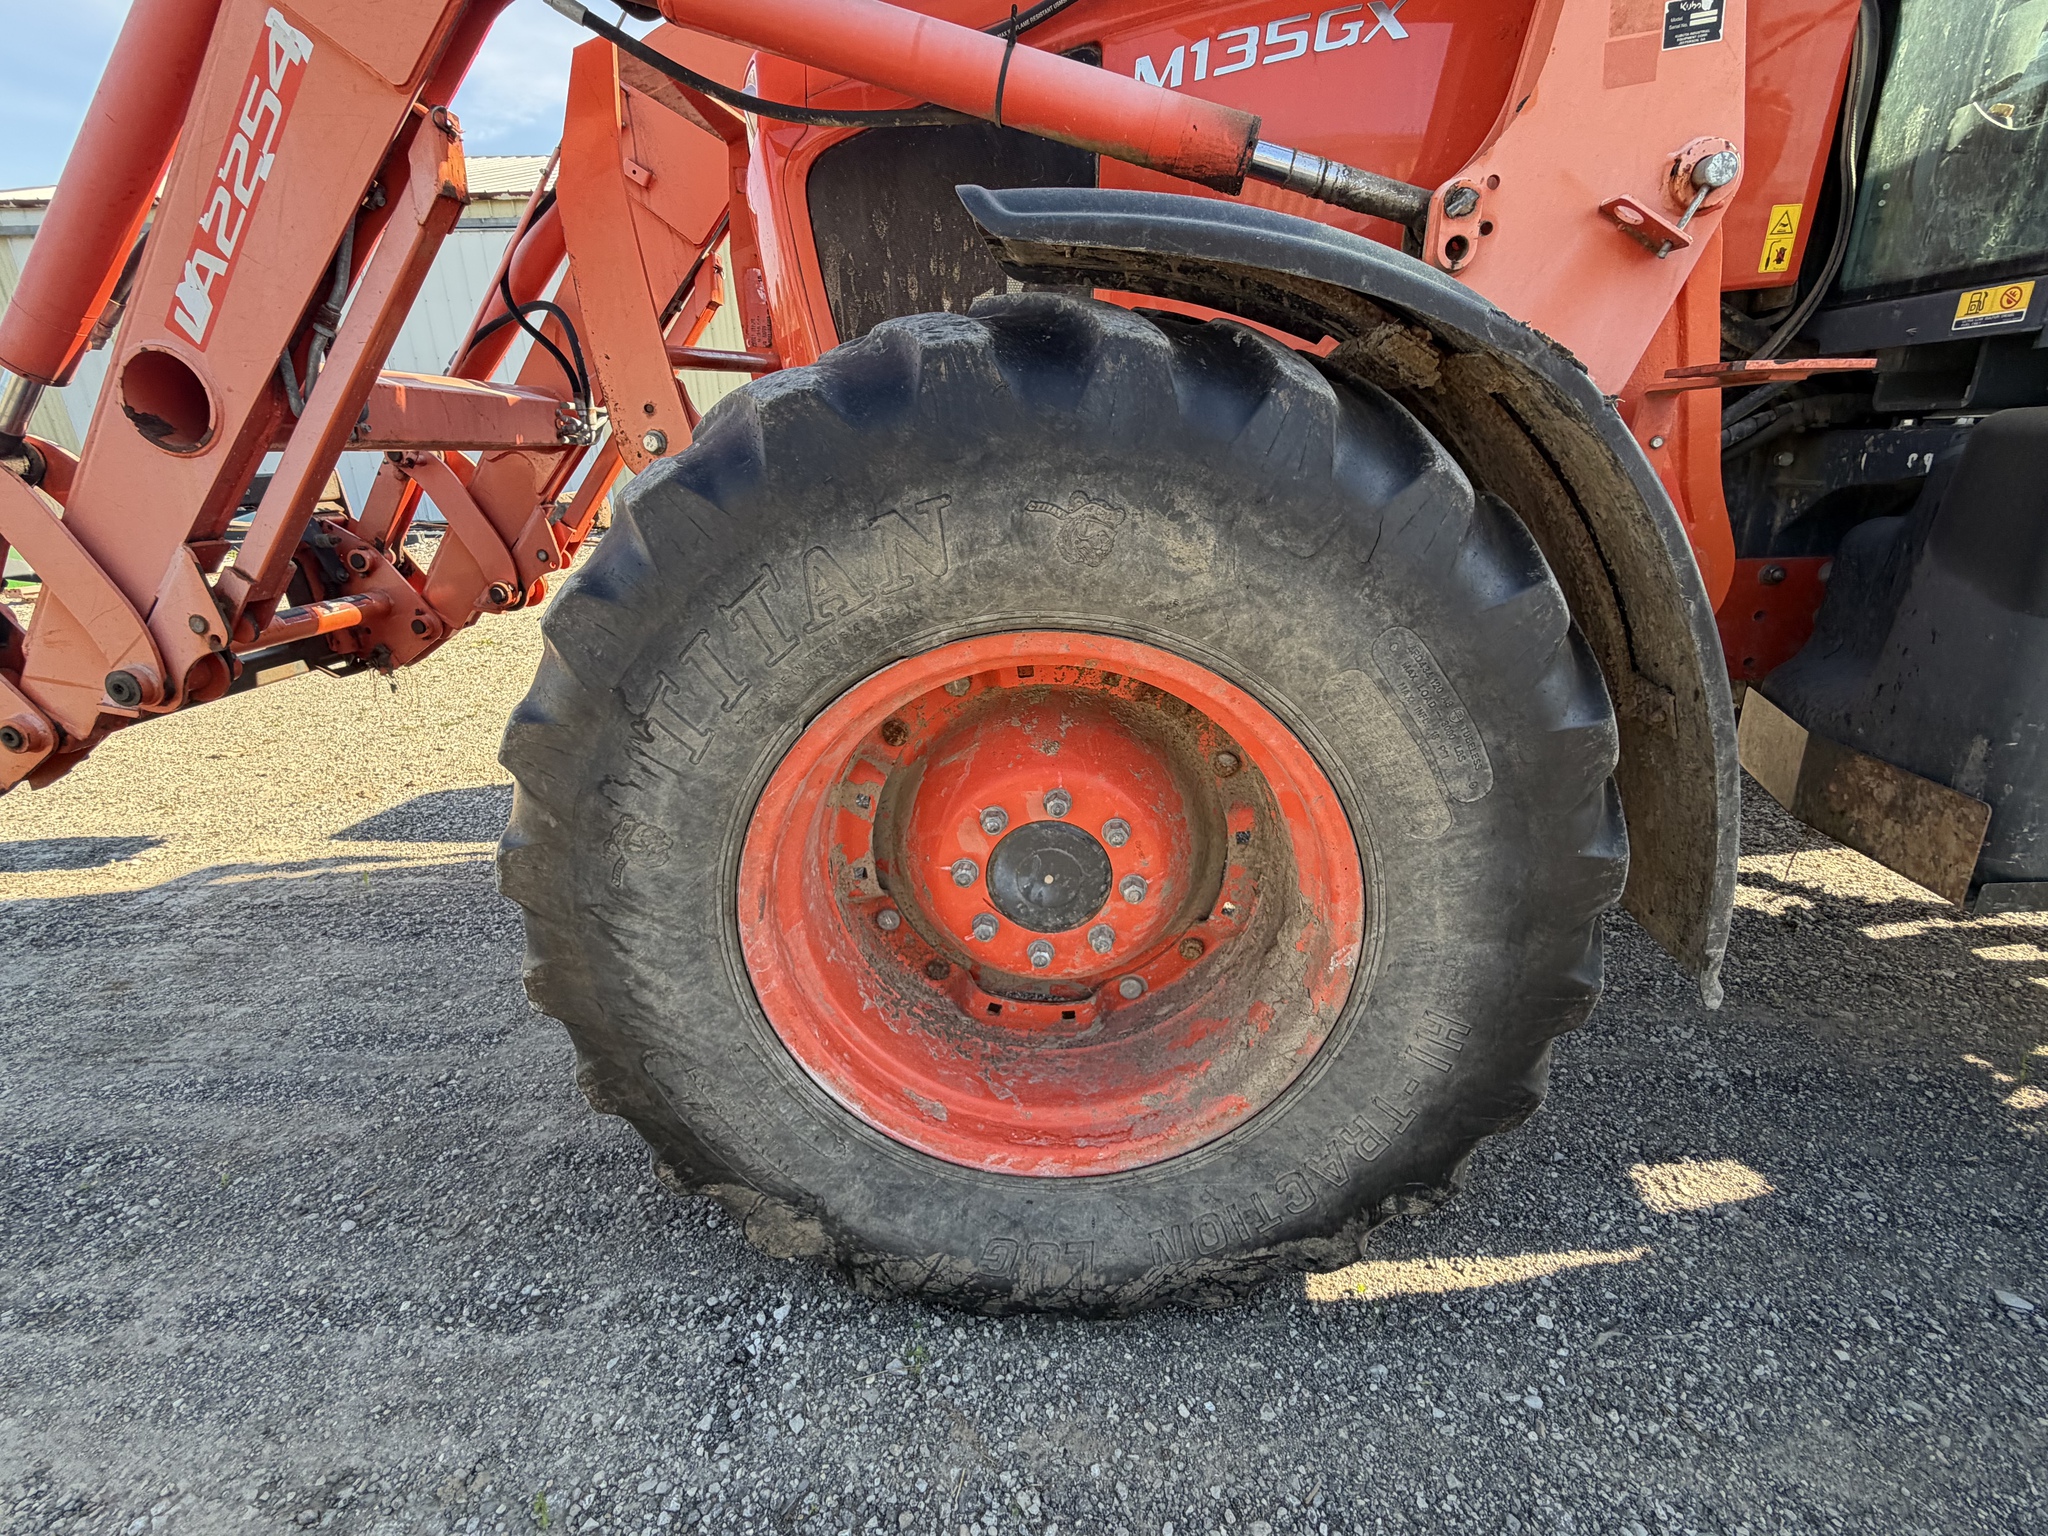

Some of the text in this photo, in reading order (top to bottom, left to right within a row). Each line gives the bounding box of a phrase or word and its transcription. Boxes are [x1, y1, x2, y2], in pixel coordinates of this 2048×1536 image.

[1029, 6, 1053, 24] RESISTANT
[1134, 1, 1409, 88] M135GX
[631, 493, 952, 766] TITAN
[759, 675, 788, 703] MADE
[791, 662, 805, 676] IN
[1416, 684, 1437, 708] LOAD
[1453, 745, 1466, 763] LBS
[1460, 726, 1483, 771] TUBELESS
